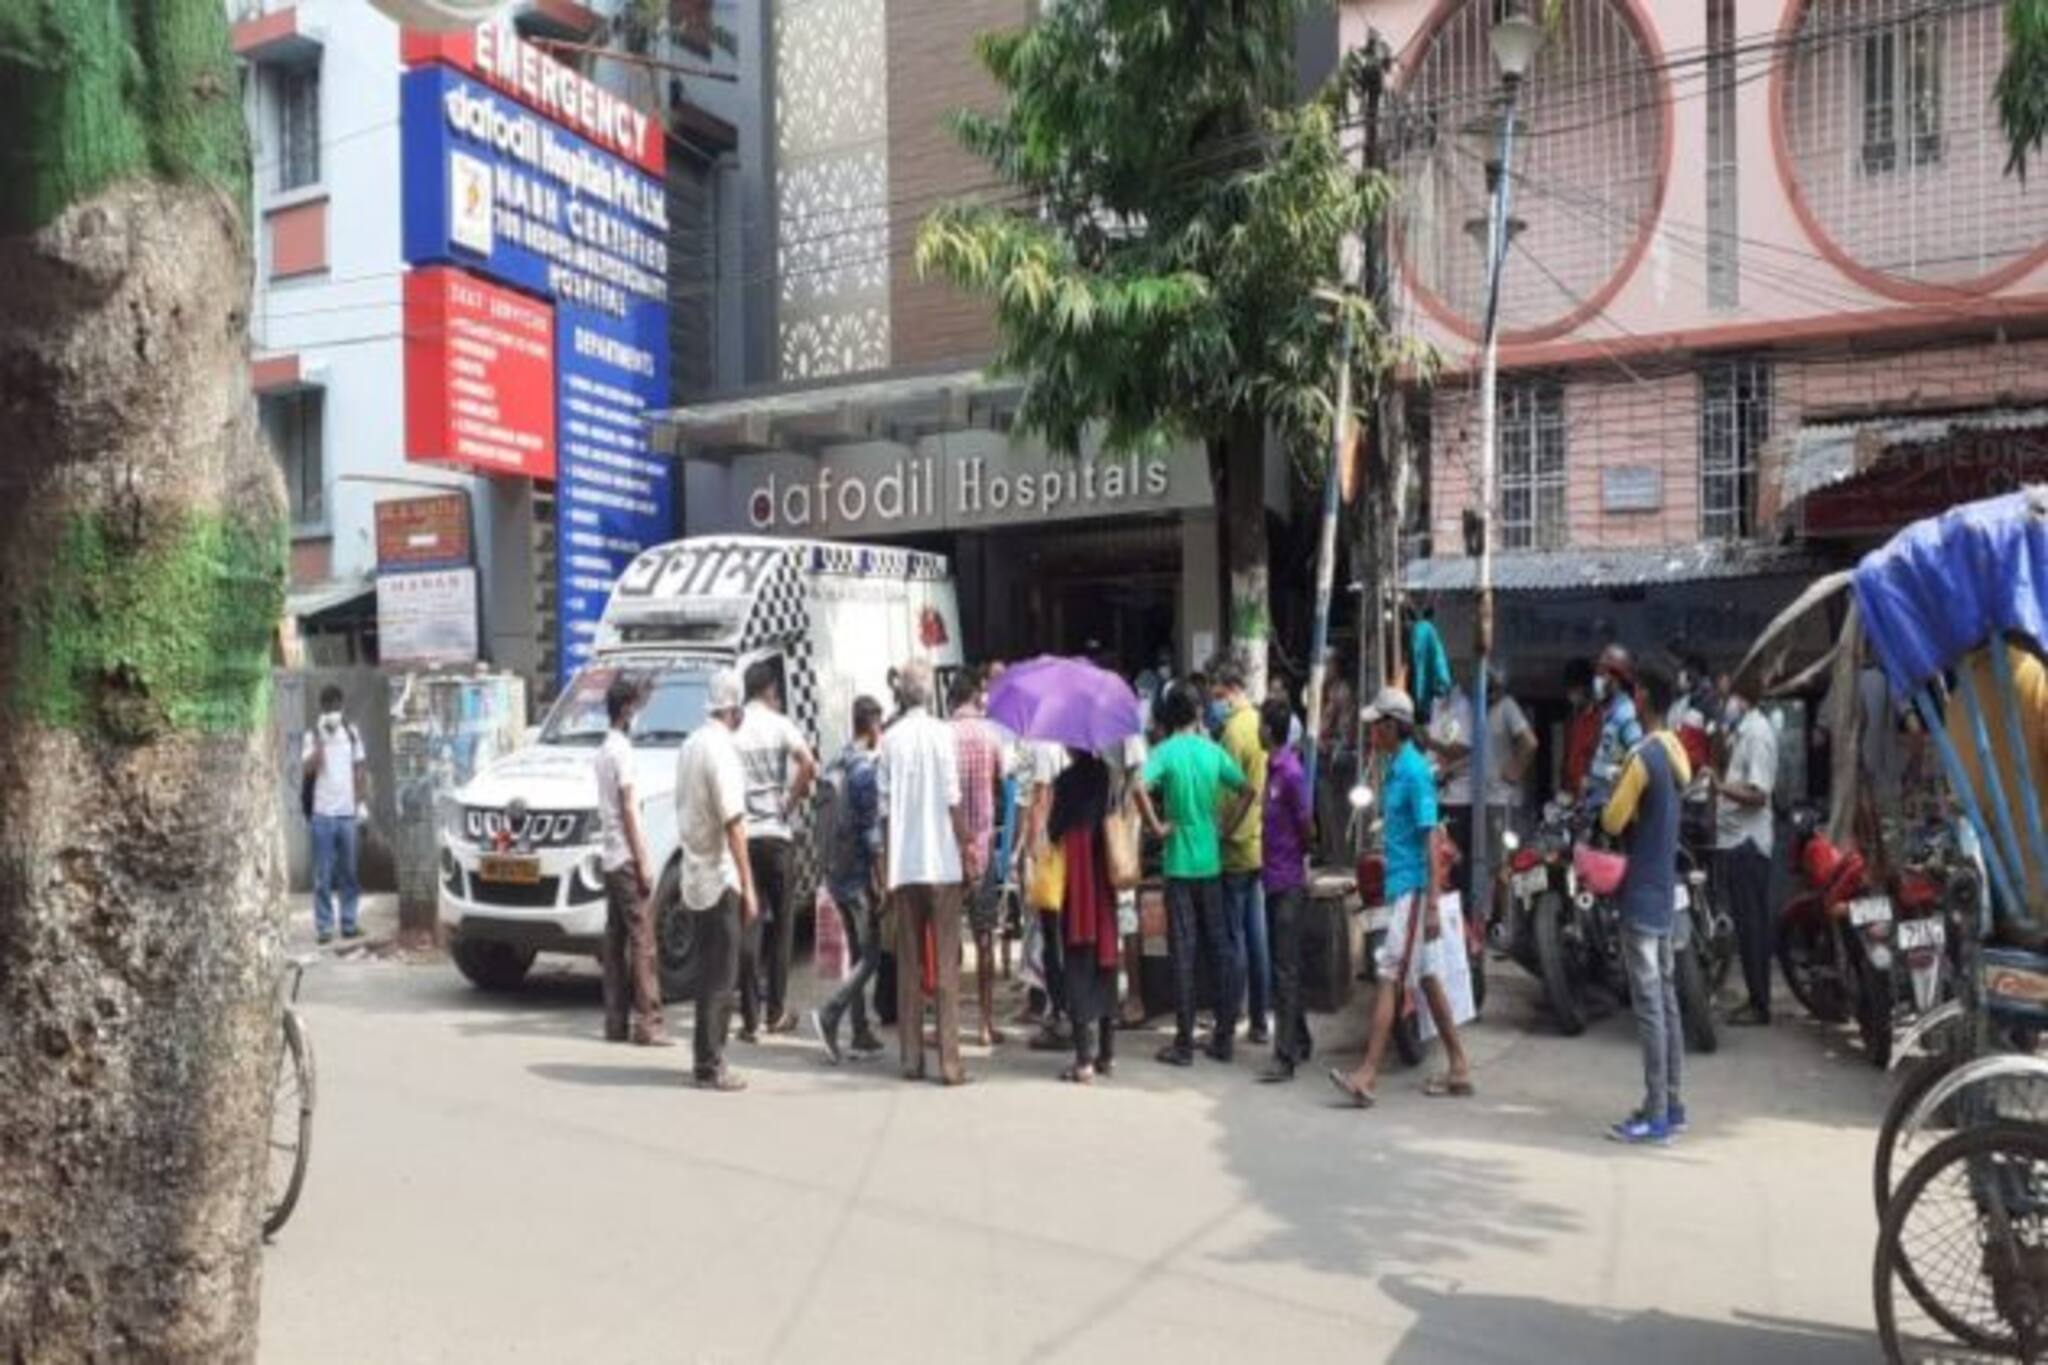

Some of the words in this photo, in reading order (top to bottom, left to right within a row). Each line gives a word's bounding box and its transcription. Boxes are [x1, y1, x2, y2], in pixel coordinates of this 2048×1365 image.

[444, 83, 538, 166] dafodil
[475, 17, 648, 157] EMERGENCY
[749, 458, 935, 528] dafodil
[957, 450, 1168, 513] Hospitals
